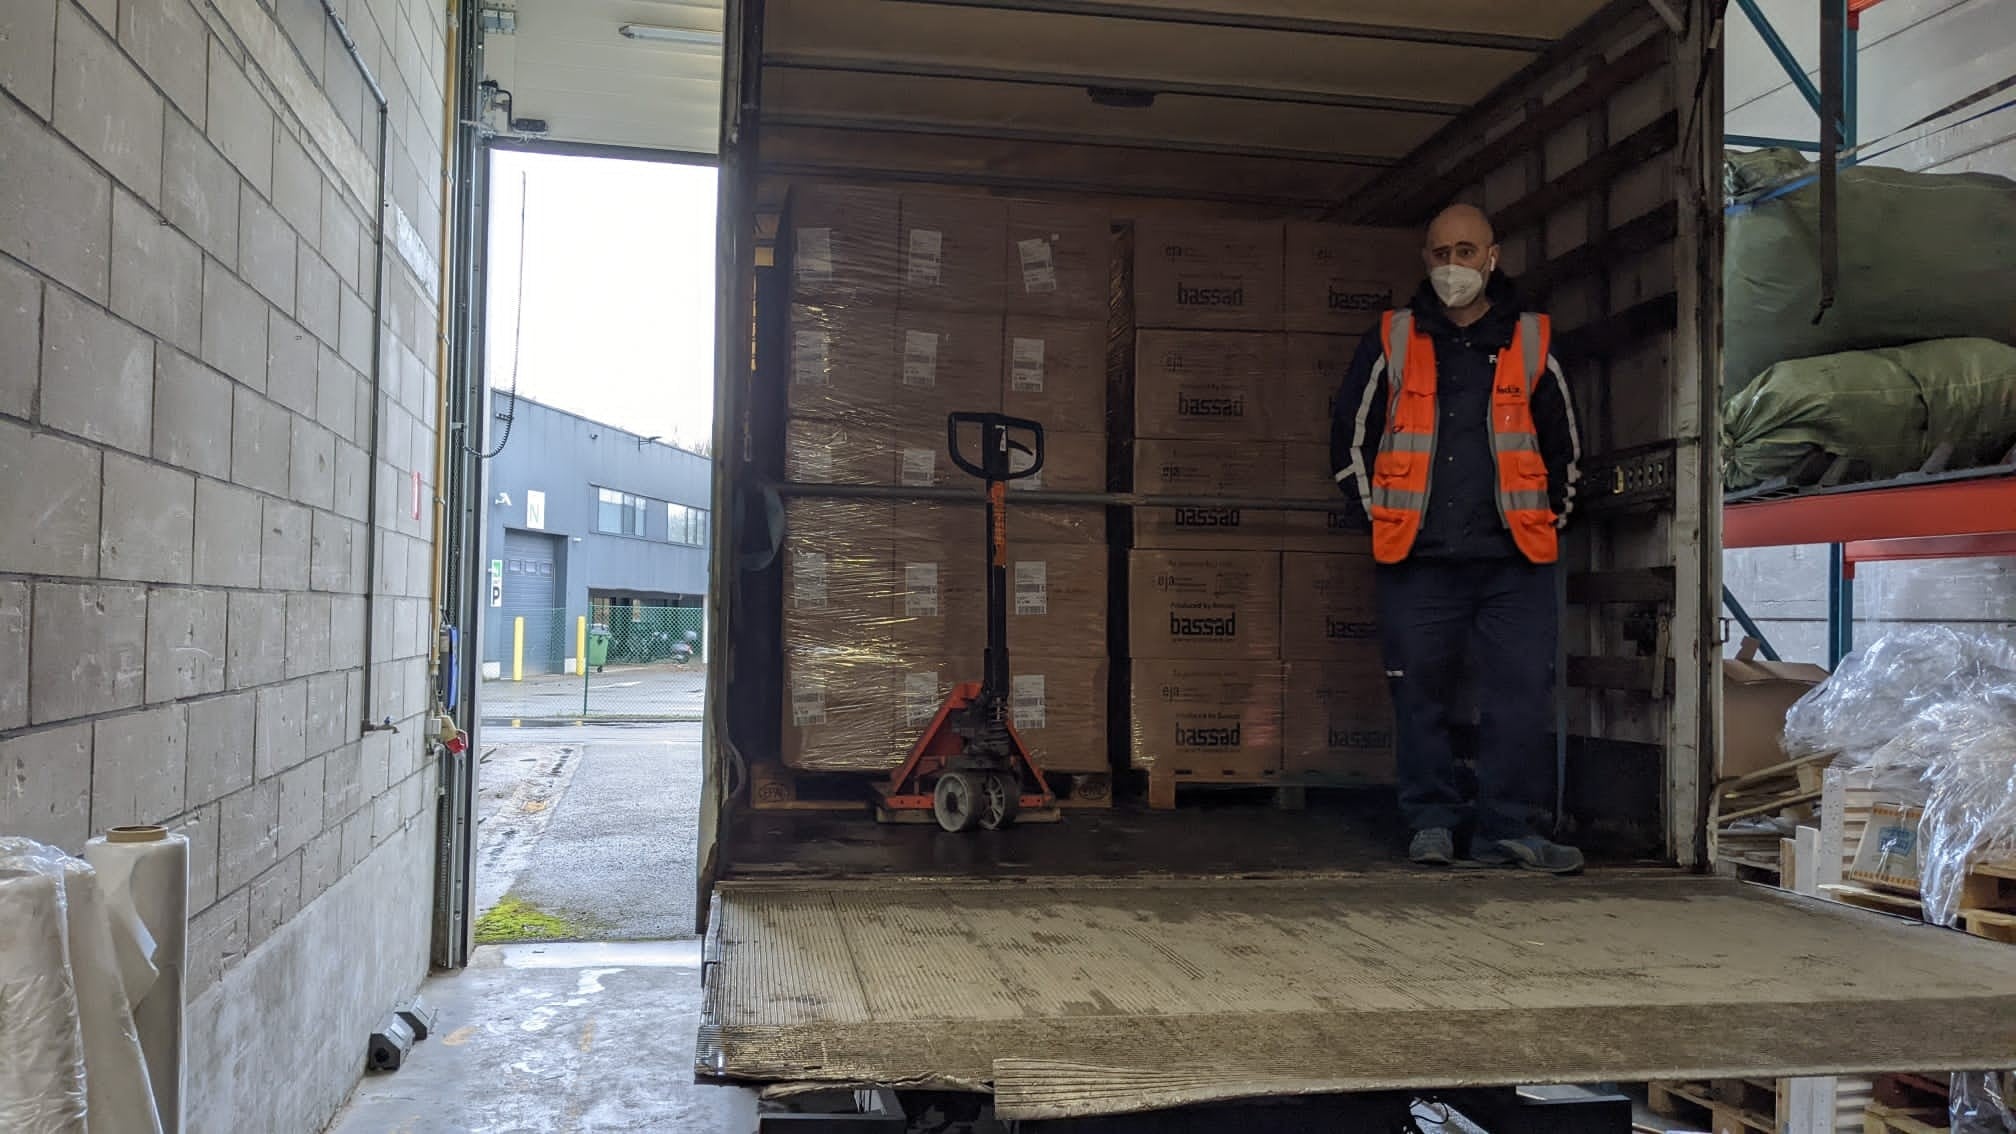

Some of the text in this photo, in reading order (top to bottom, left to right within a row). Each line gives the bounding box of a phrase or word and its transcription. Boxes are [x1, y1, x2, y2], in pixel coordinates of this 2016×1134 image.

[492, 586, 501, 604] P
[1170, 611, 1236, 636] bassad
[1175, 720, 1241, 746] bassad
